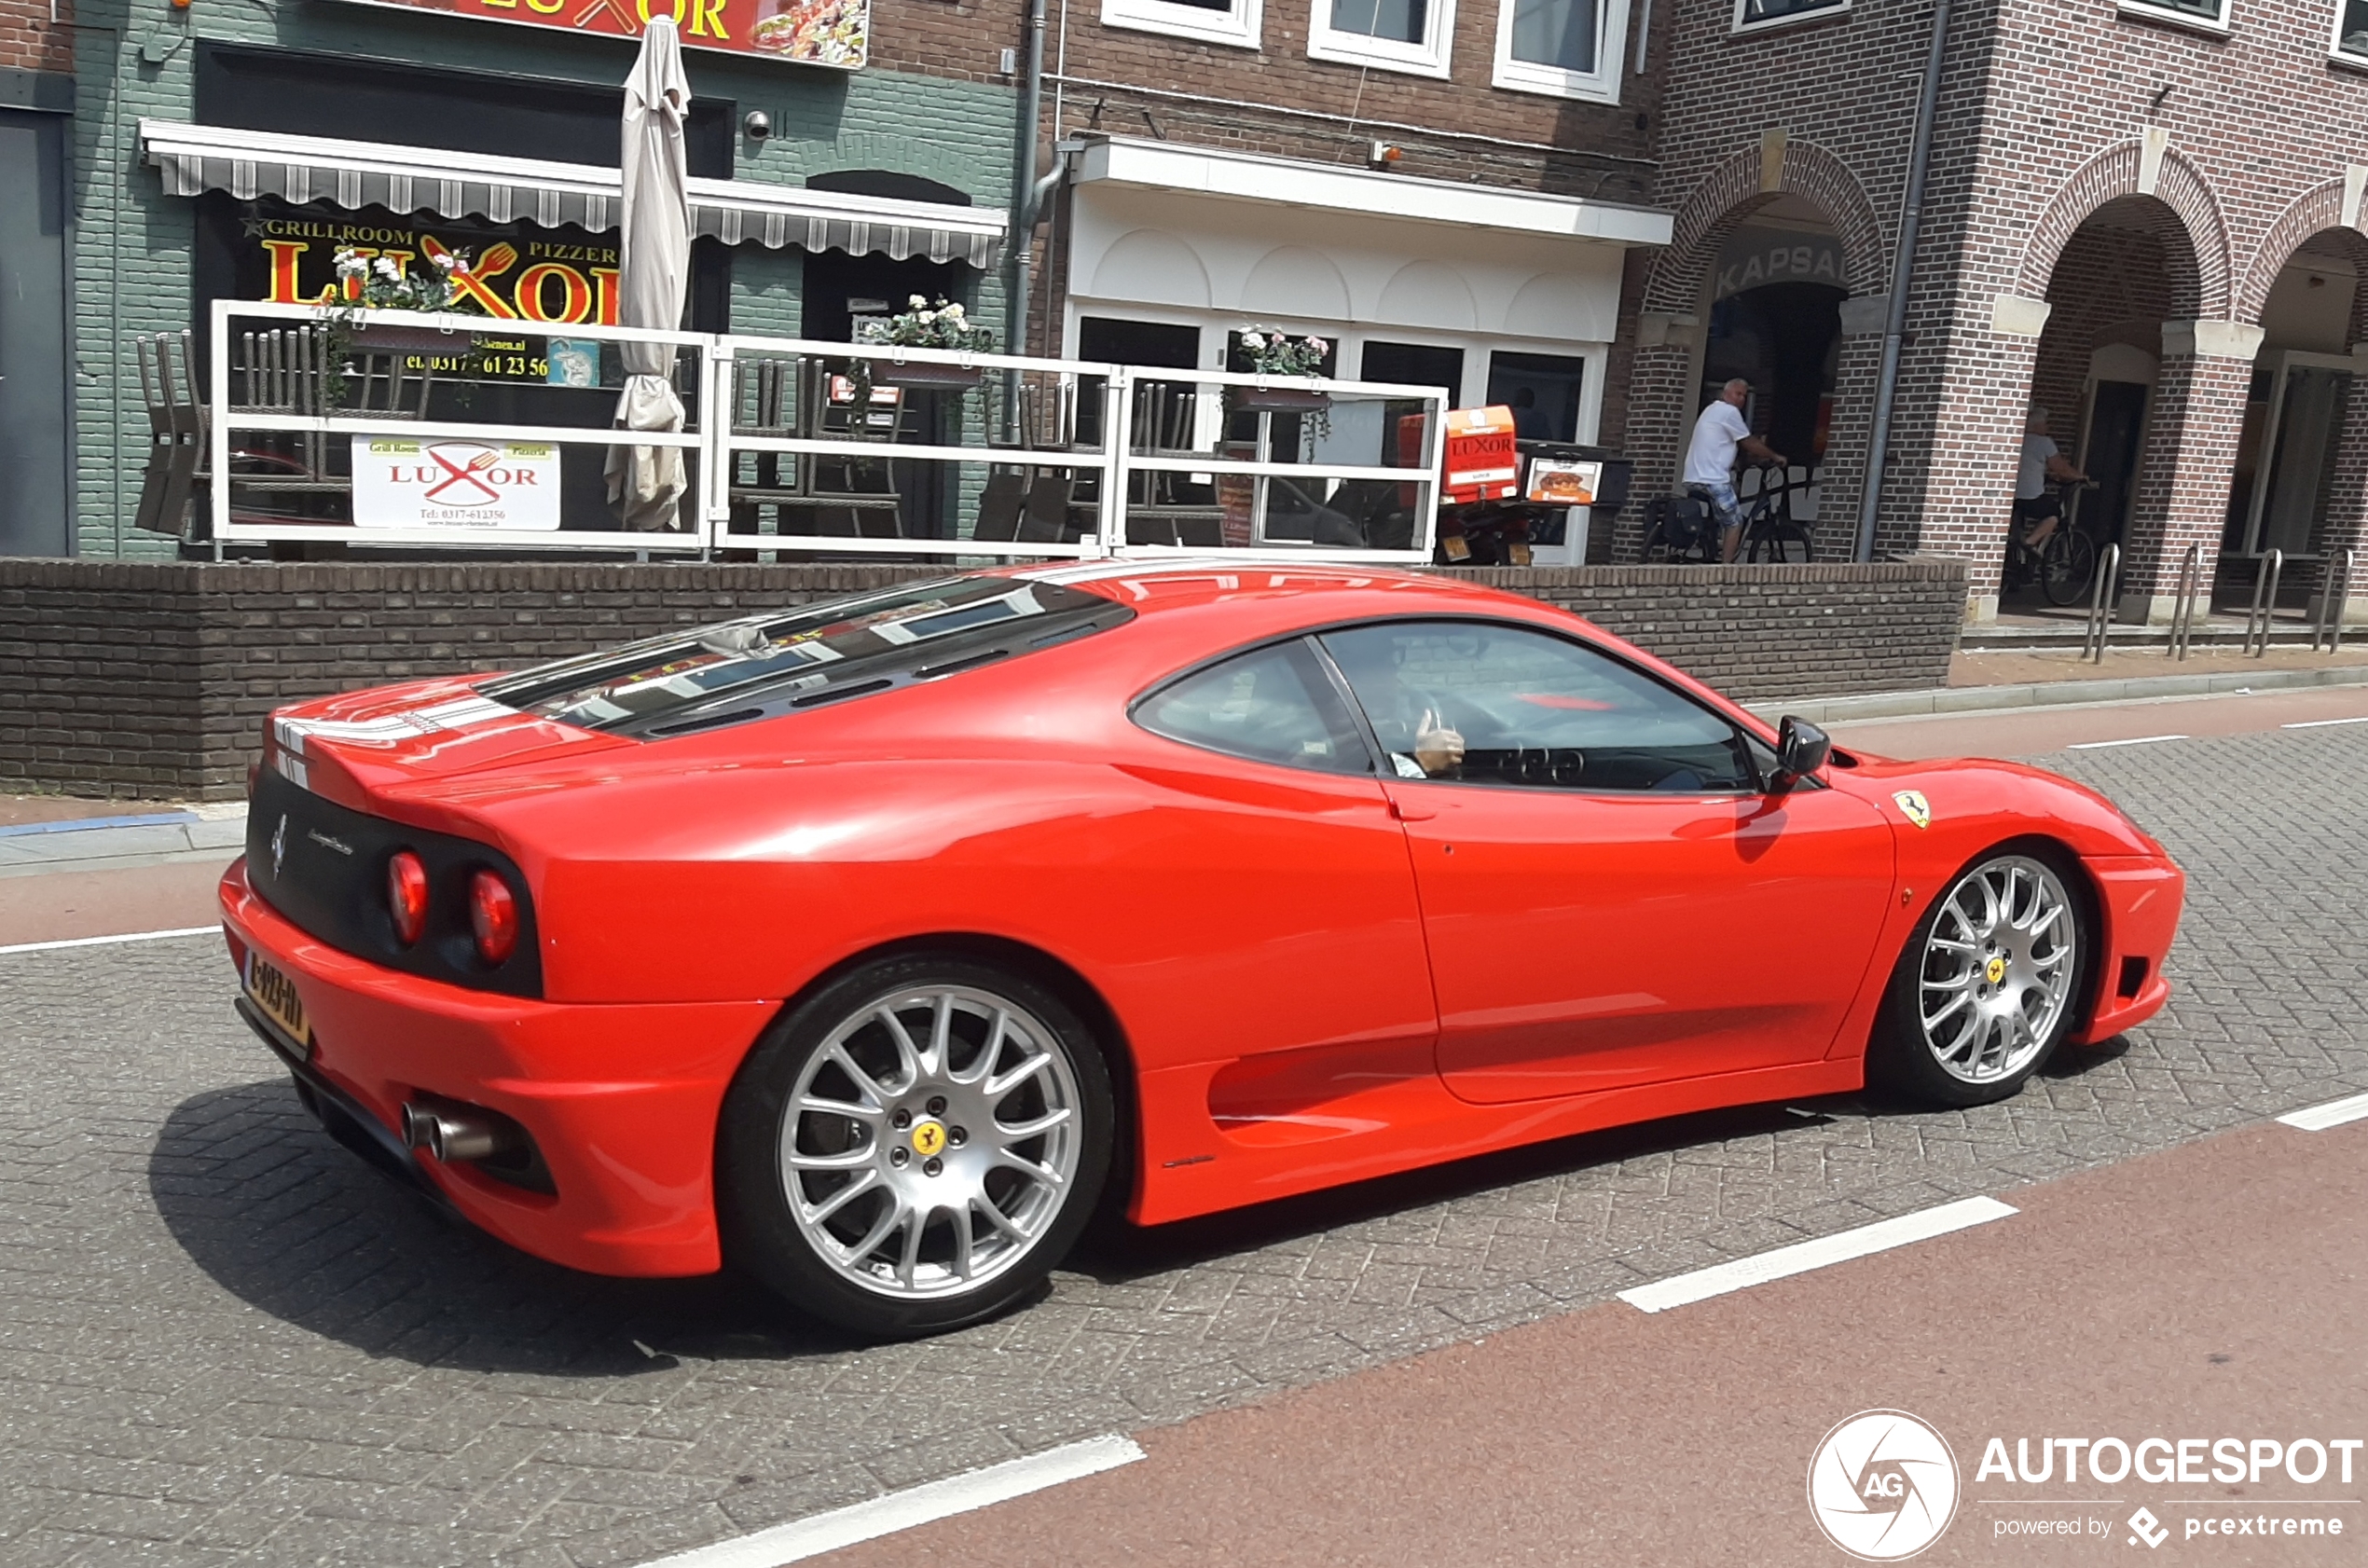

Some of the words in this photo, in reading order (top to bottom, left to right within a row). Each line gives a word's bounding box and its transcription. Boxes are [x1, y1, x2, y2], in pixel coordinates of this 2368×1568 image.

[267, 218, 413, 244] GRILLROOM
[506, 356, 525, 376] 23
[529, 358, 548, 377] 56
[389, 449, 539, 499] LUXOR
